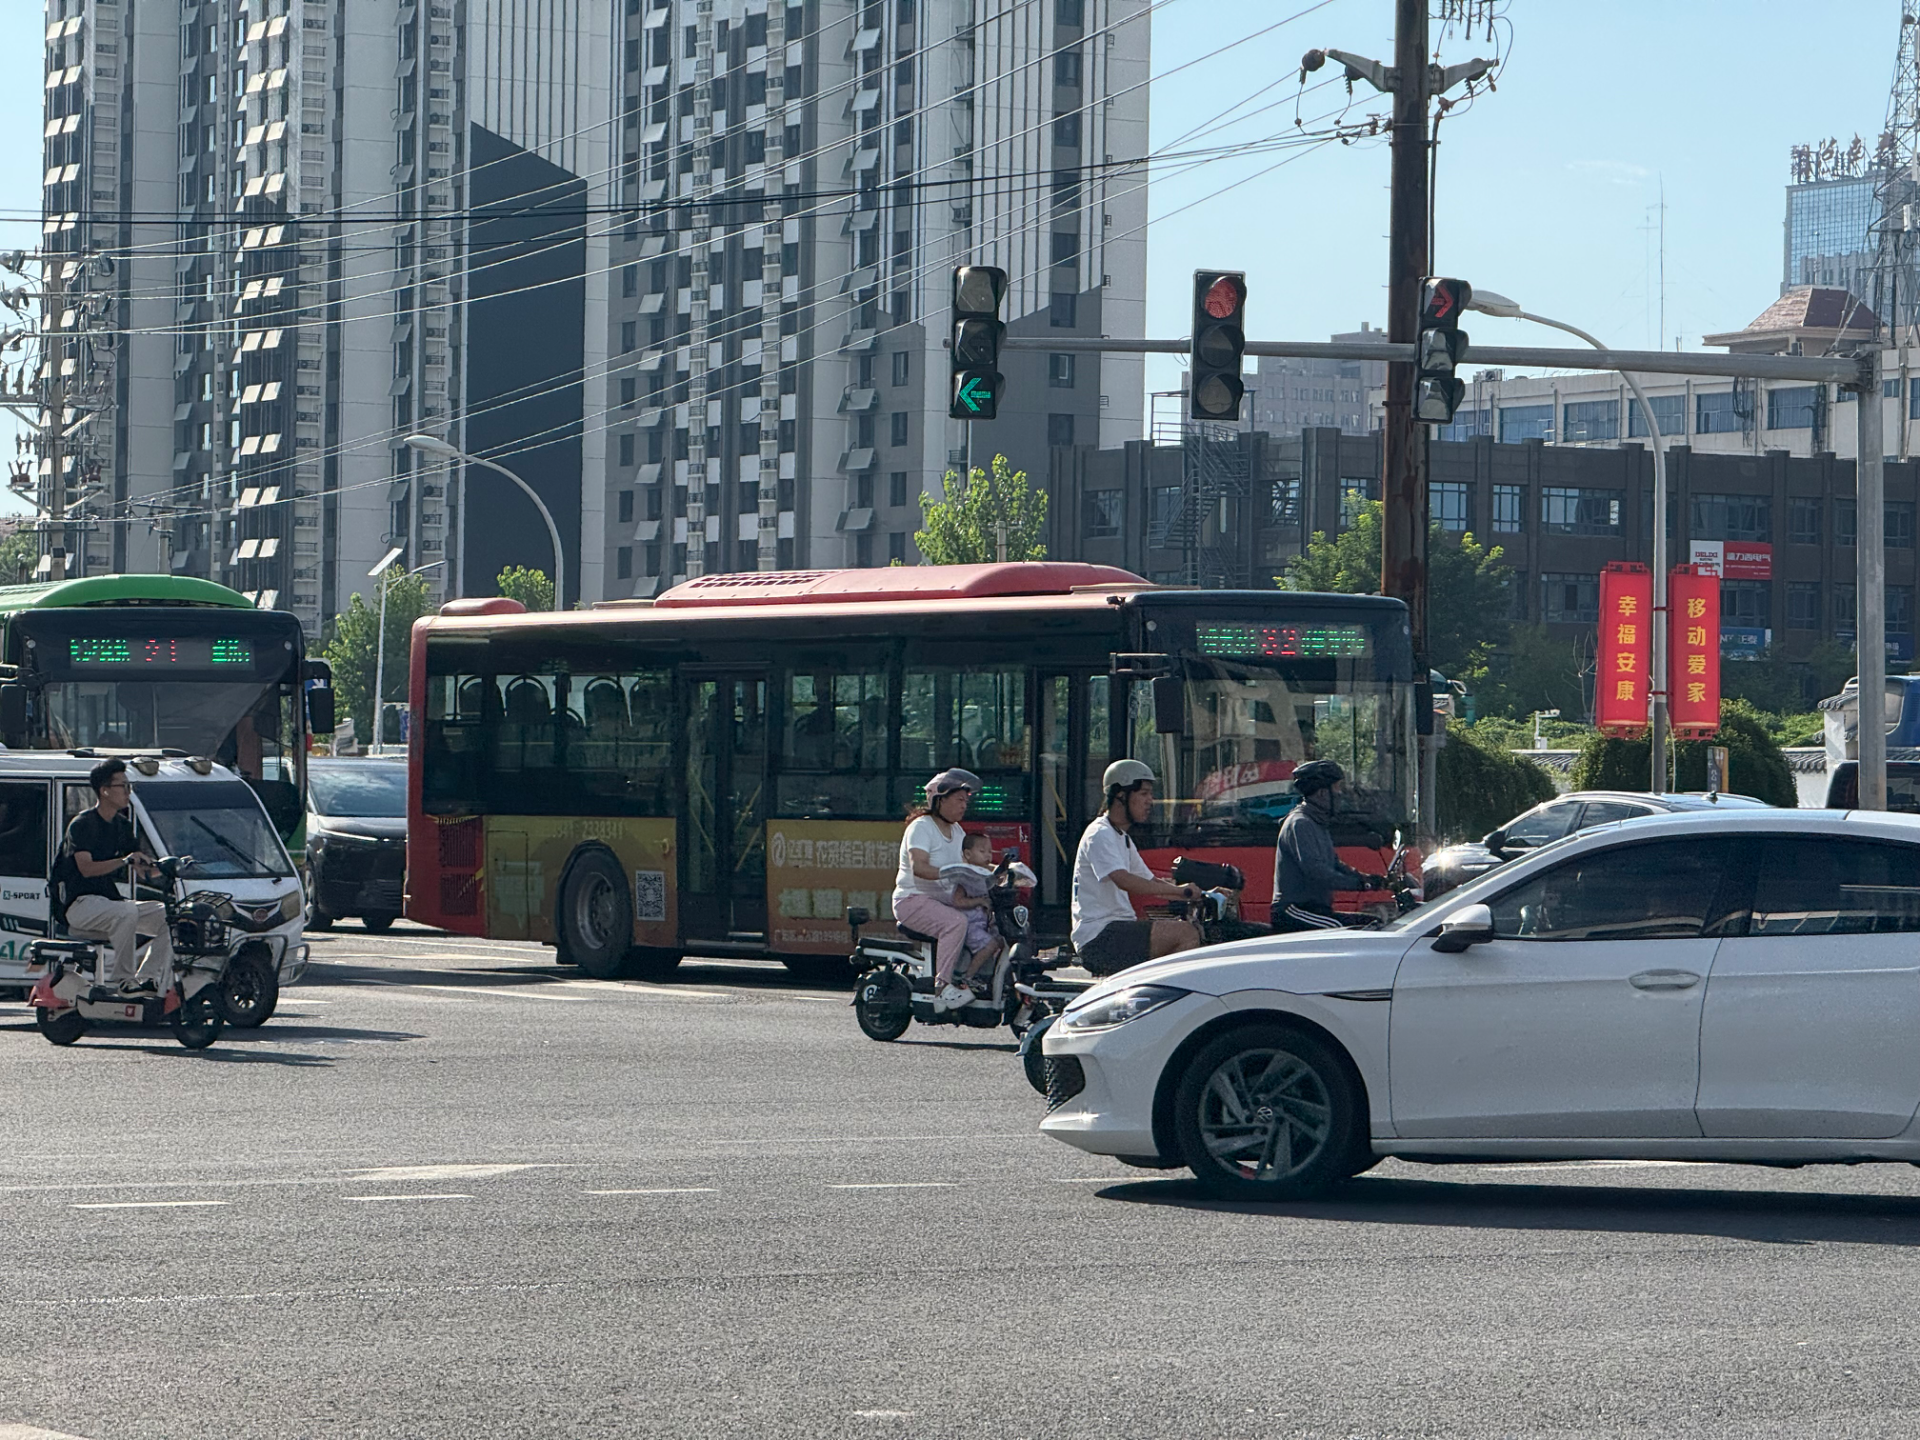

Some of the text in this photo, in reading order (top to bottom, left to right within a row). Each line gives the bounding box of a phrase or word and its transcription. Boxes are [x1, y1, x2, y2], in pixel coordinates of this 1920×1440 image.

[1616, 596, 1637, 701] 幸福安康
[1687, 598, 1706, 703] 移动爱家
